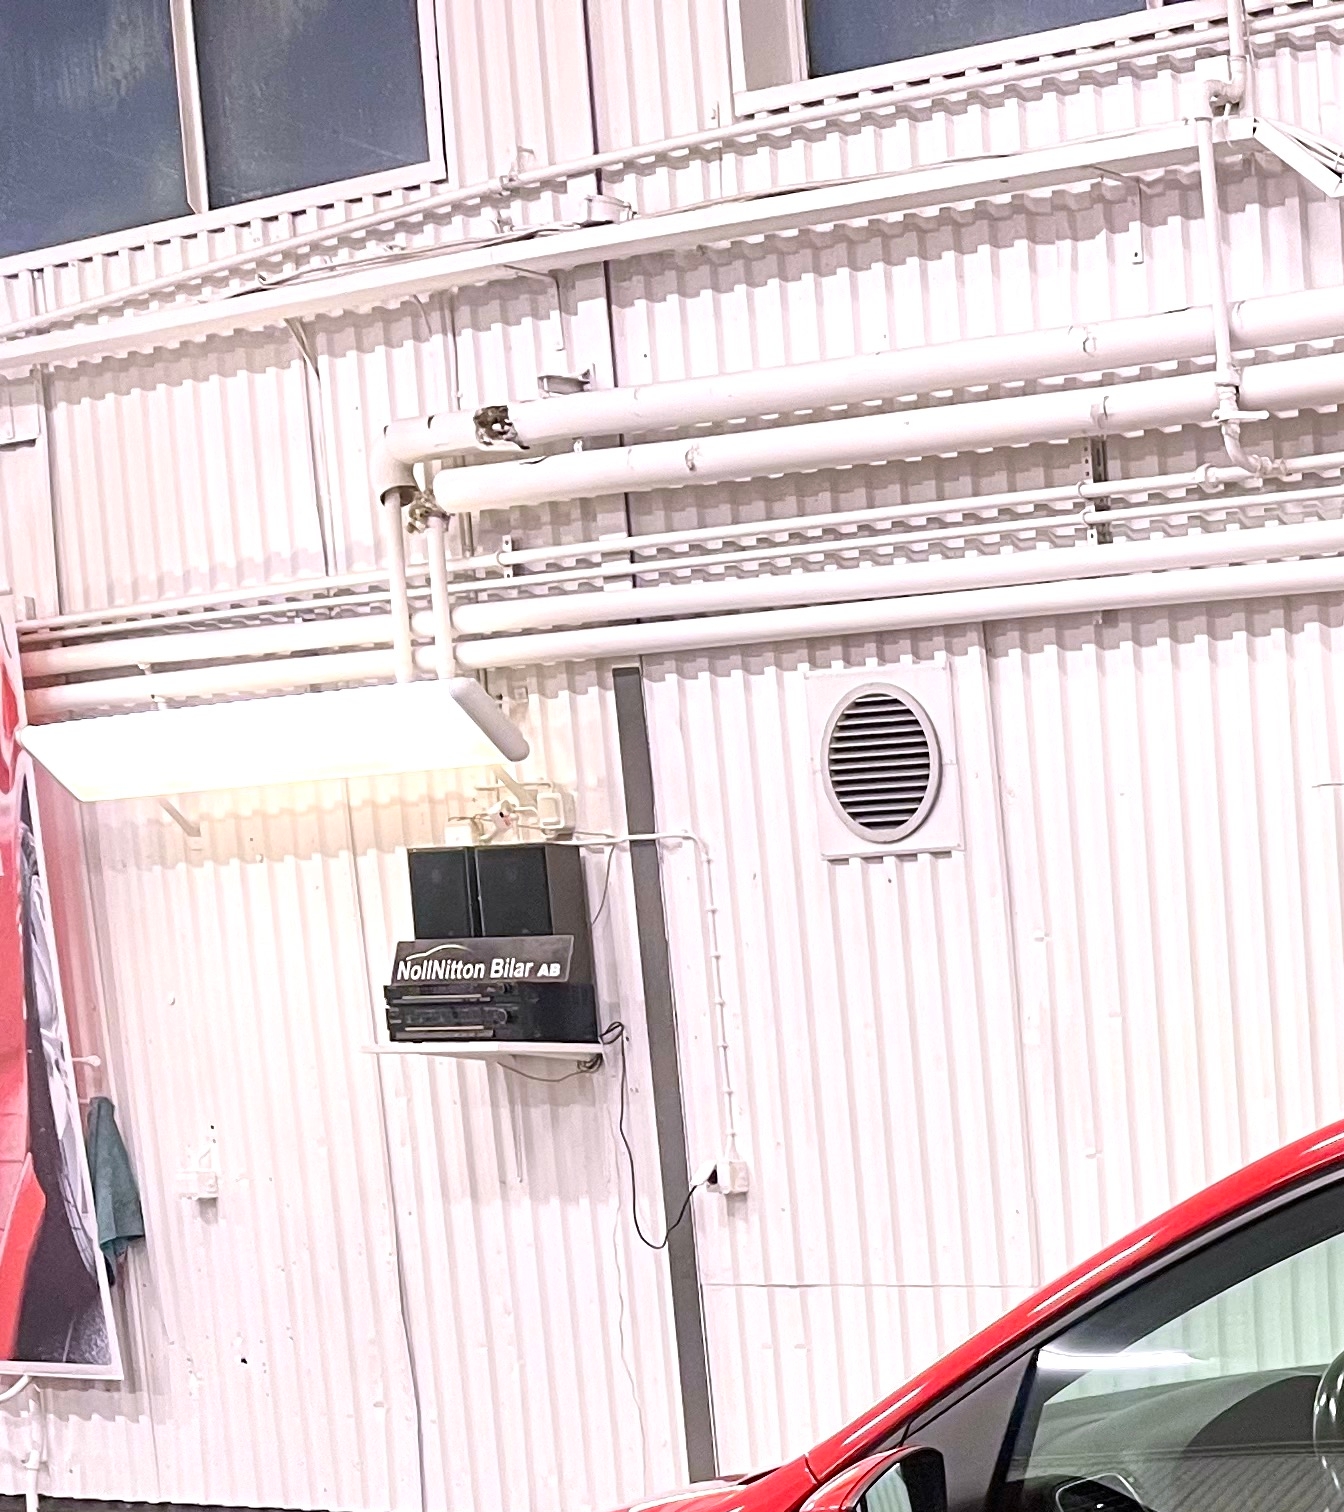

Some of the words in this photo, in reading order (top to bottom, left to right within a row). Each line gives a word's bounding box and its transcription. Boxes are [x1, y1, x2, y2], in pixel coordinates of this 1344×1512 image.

[396, 959, 486, 981] NollNitton
[489, 957, 535, 979] Bilar
[537, 962, 561, 978] AB
